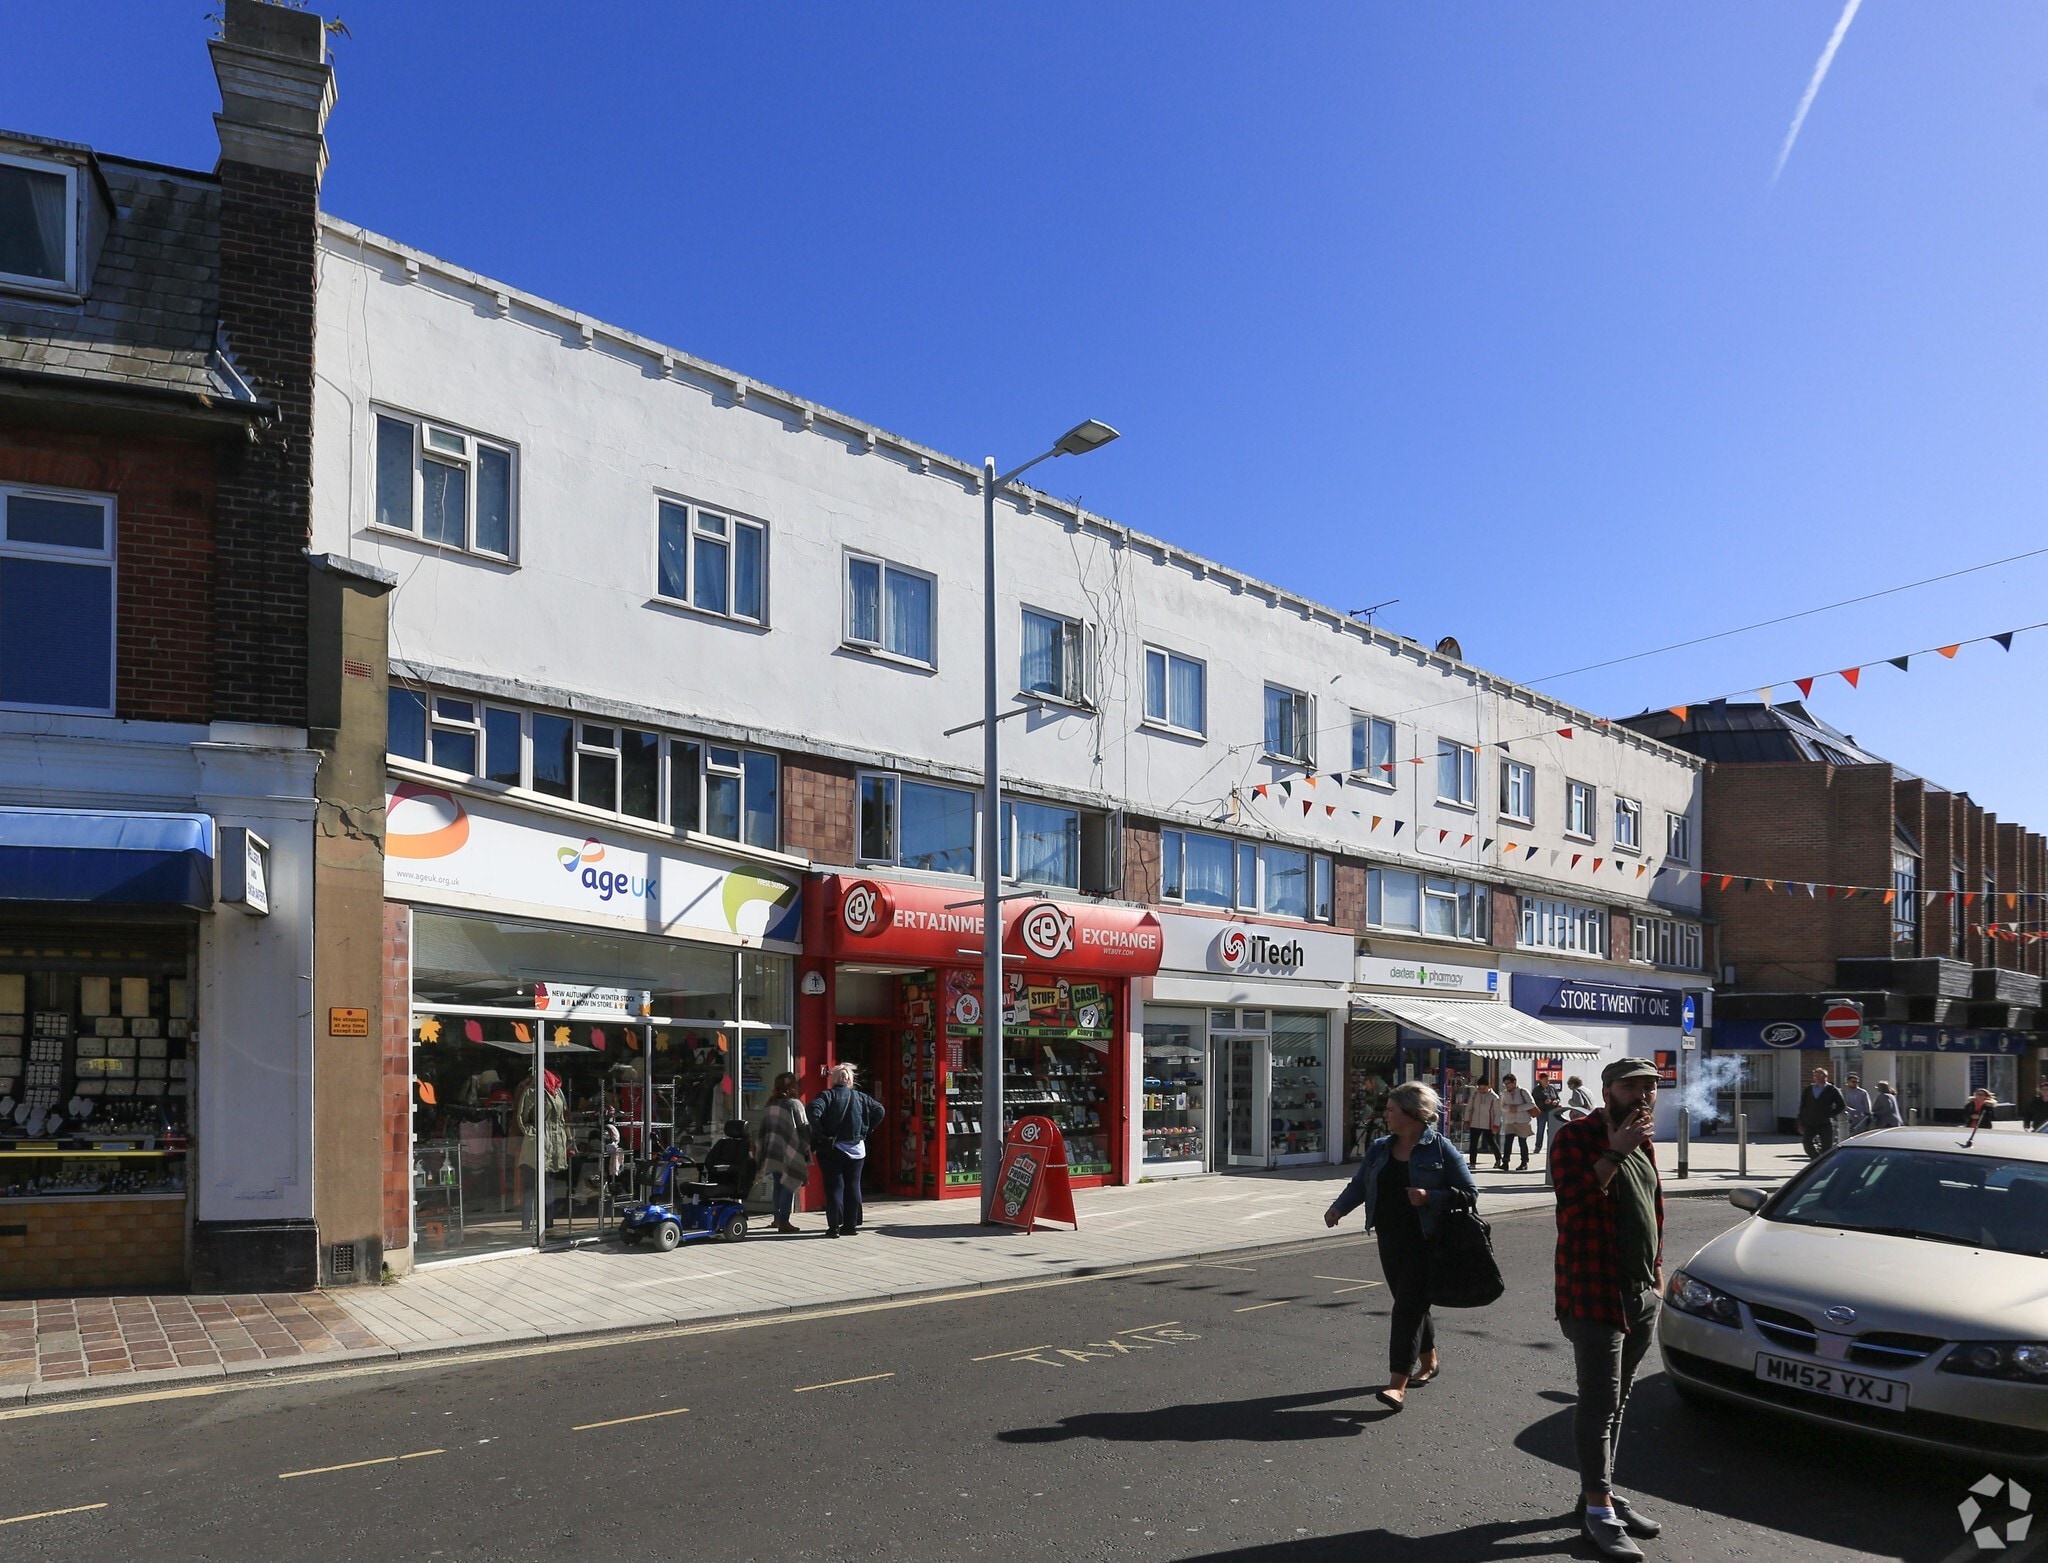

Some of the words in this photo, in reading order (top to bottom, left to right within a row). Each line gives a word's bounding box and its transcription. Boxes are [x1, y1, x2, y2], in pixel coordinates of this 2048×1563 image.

[396, 870, 460, 886] www.ageuk.org.uk
[581, 867, 628, 901] age
[632, 876, 657, 900] UK
[1082, 927, 1156, 950] EXCHANGE
[1103, 947, 1134, 956] WEBUY.COM
[1251, 935, 1304, 967] iTech
[1390, 966, 1415, 979] dexters
[1429, 970, 1464, 984] pharmacy
[566, 991, 589, 999] AUTUMN
[1031, 991, 1056, 1005] STUFF
[1074, 987, 1098, 1003] CASH
[1561, 990, 1597, 1011] STORE
[1600, 993, 1646, 1015] TWENTY
[1649, 998, 1669, 1016] ONE
[1009, 1168, 1031, 1185] PHONES
[1006, 1182, 1024, 1199] CASH
[1767, 1358, 1832, 1391] MM52
[1840, 1373, 1894, 1404] YXJ
